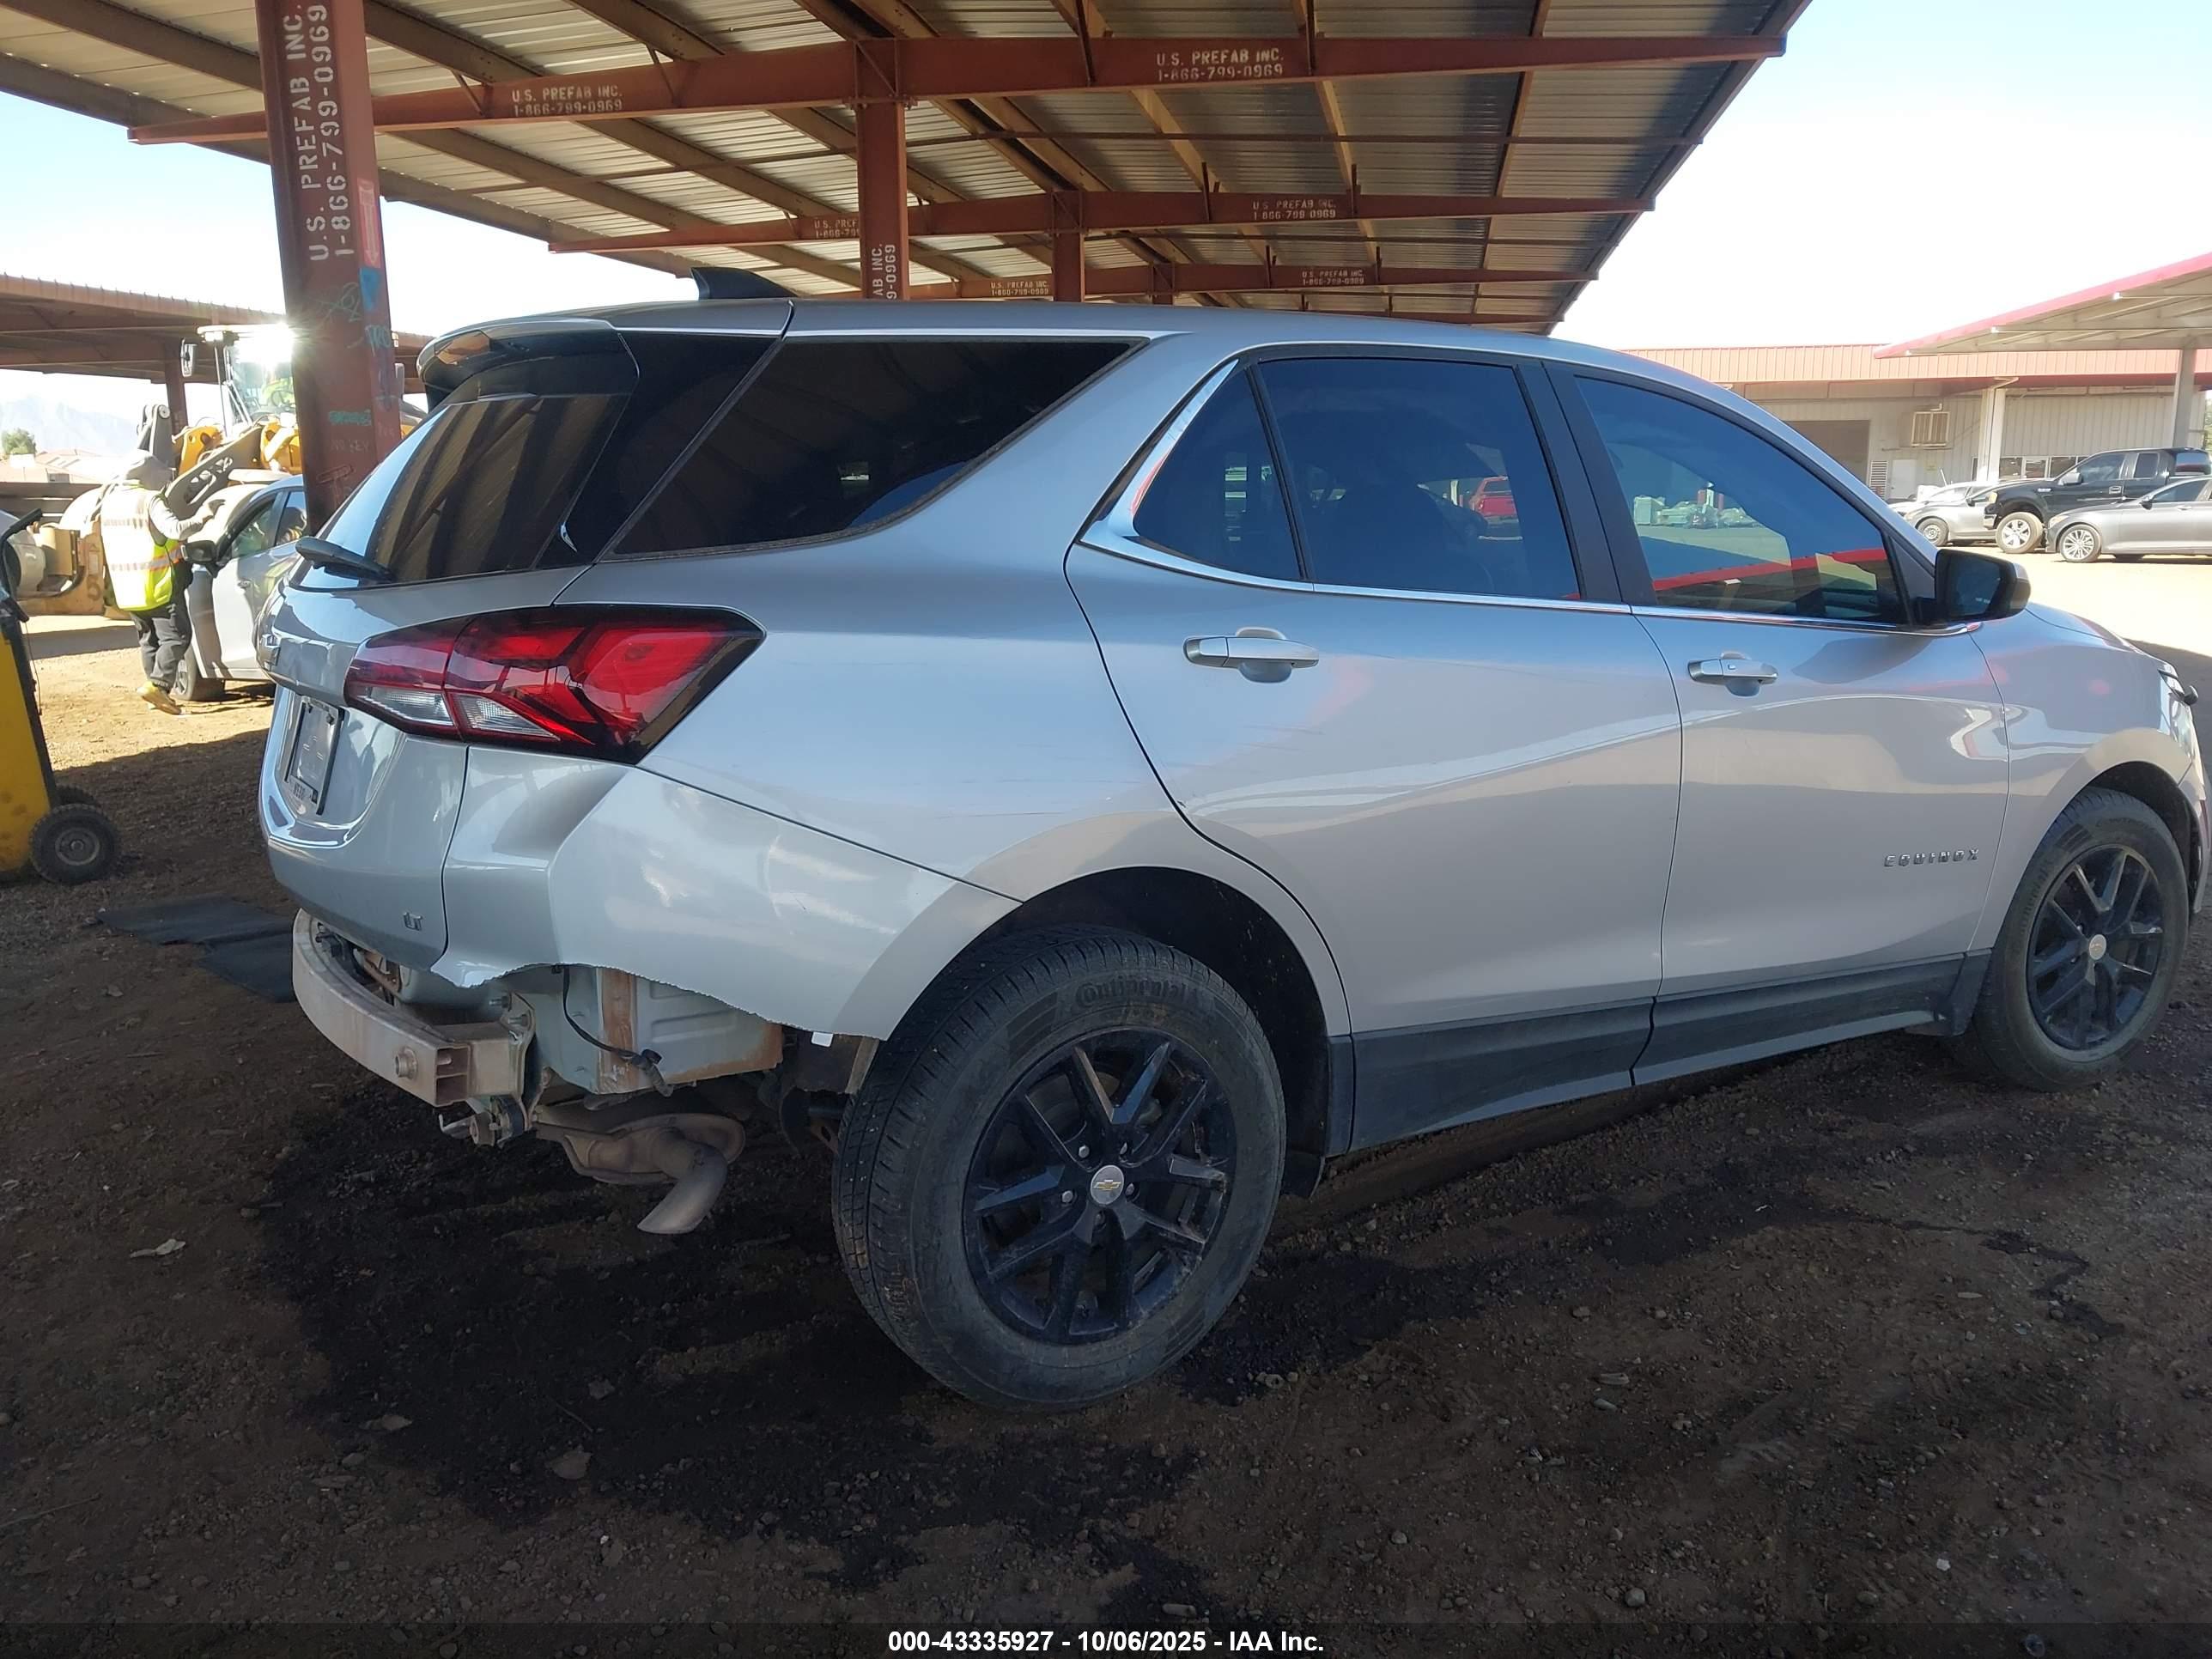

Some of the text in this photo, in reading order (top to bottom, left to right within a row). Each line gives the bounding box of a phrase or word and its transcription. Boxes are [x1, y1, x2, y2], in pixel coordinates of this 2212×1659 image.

[283, 4, 307, 60] INC.
[1191, 48, 1249, 64] PREFAB
[1255, 47, 1285, 62] INC.
[542, 85, 592, 100] PREFAB
[598, 84, 623, 98] INC.
[289, 76, 321, 189] PREFAB
[307, 4, 355, 257] 1-866-799-0969
[1276, 199, 1314, 210] PREFAB
[305, 205, 347, 261] U.S.
[872, 243, 884, 270] INC.
[403, 911, 423, 932] LT
